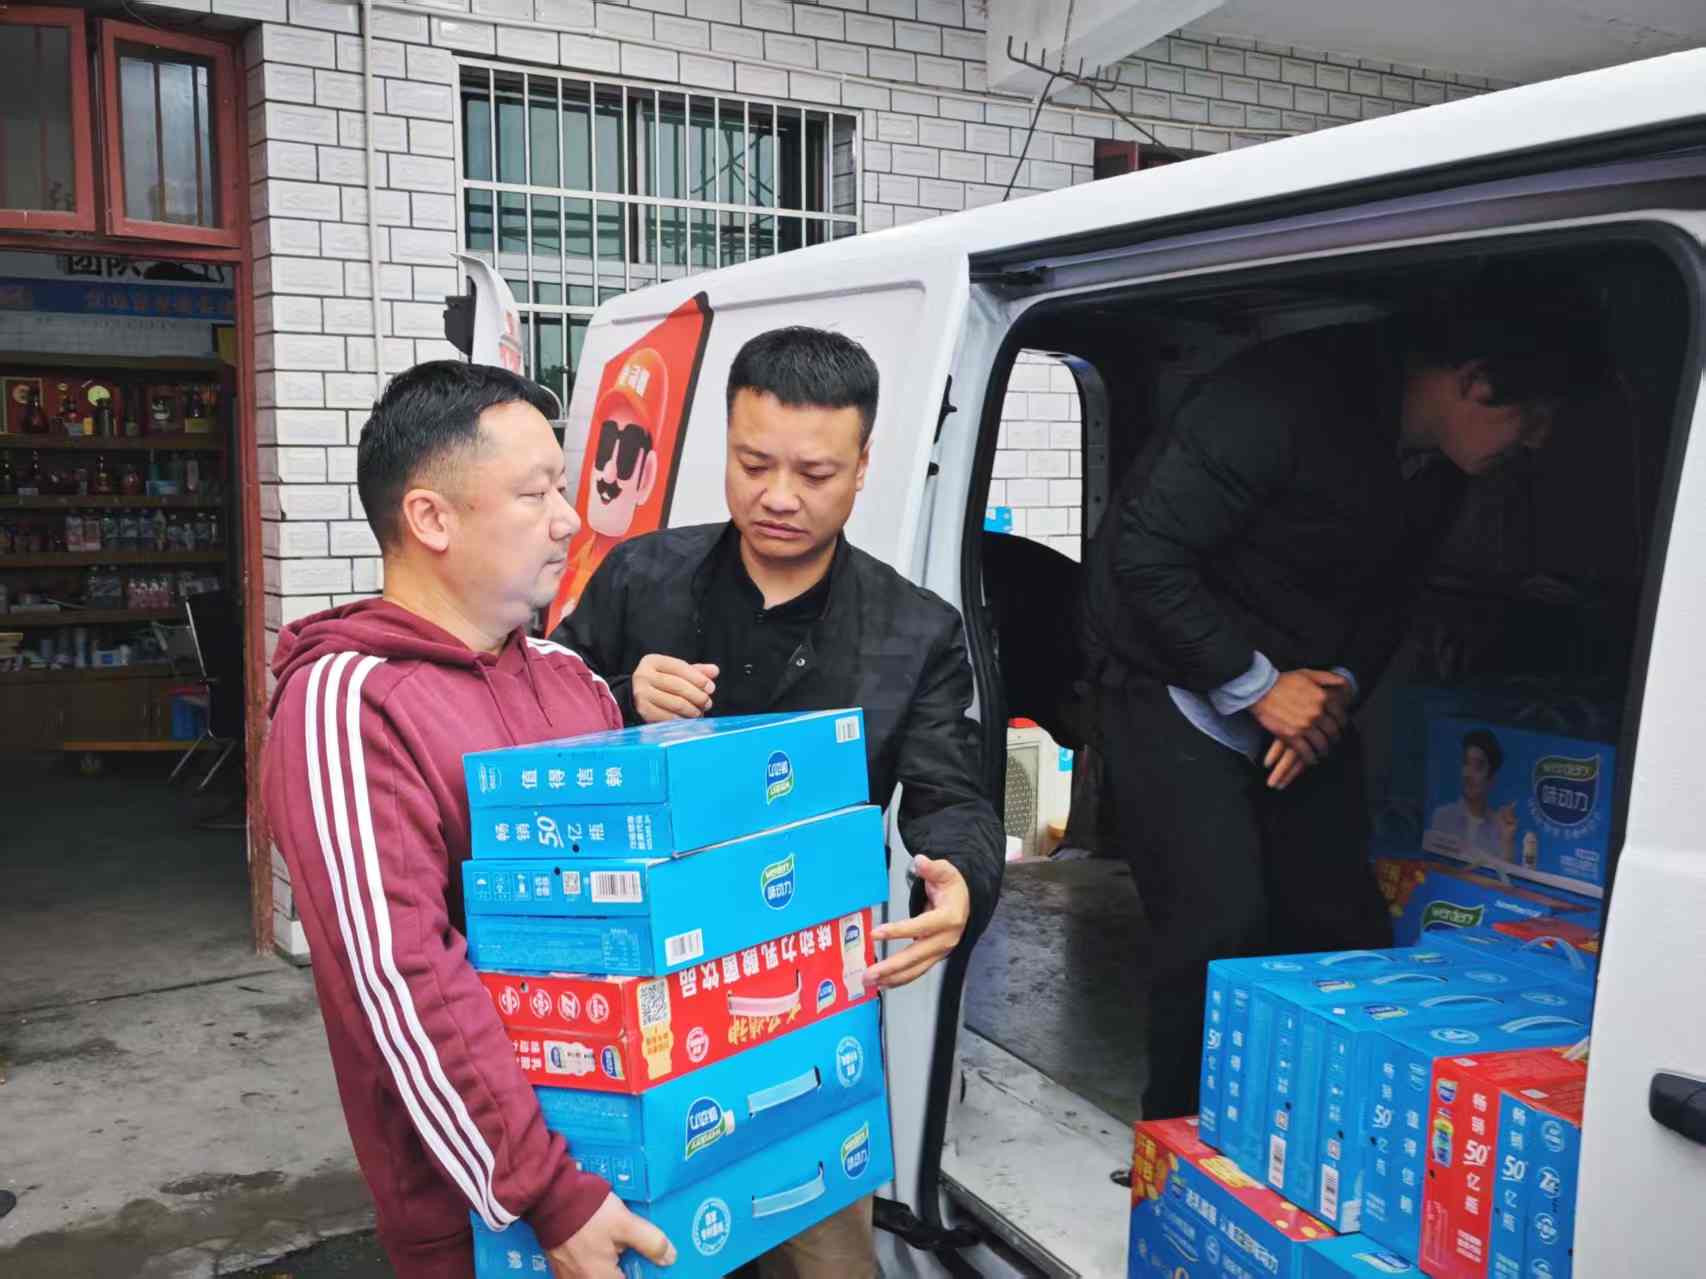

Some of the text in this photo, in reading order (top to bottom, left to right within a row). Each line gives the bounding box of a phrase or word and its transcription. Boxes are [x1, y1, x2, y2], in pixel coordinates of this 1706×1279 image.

[521, 767, 624, 789] 值得信赖
[496, 815, 605, 850] 畅销50亿瓶
[680, 923, 832, 999] 味动力乳酸菌饮品
[1463, 1092, 1492, 1215] 畅销50亿瓶
